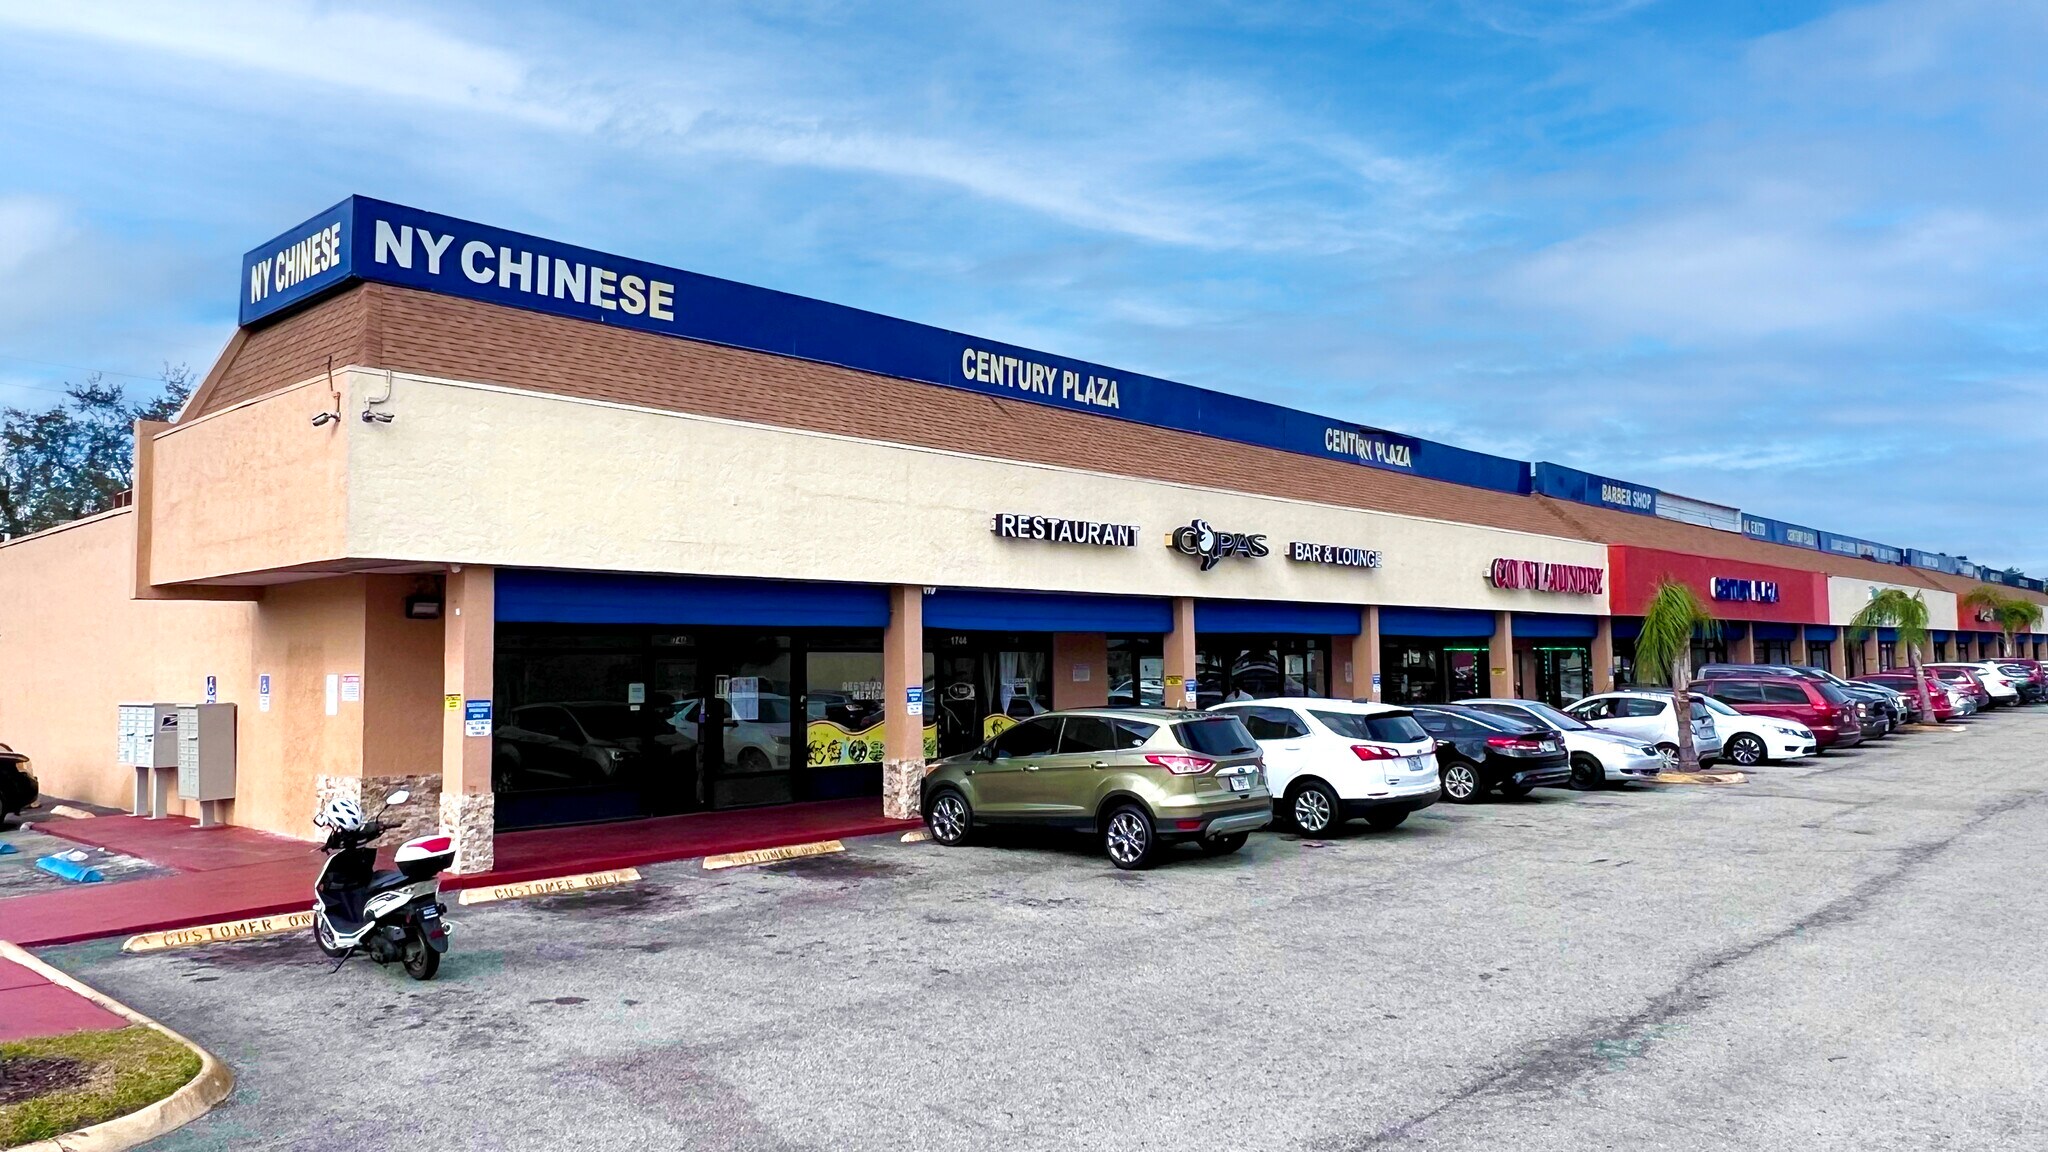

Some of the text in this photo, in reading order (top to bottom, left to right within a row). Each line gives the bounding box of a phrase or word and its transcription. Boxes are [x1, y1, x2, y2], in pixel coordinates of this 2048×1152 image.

[251, 222, 341, 304] NY CHINESE
[374, 219, 675, 321] NY CHINESE
[962, 348, 1120, 409] CENTURY PLAZA
[1375, 441, 1412, 467] PLAZA
[1602, 484, 1652, 509] BARBER SHOP
[999, 513, 1140, 547] RESTAURANT
[1295, 542, 1383, 568] BAR & LOUNGE
[1494, 558, 1603, 594] COIN LAUNDRY
[494, 873, 620, 899] CUSTOMER ONLY
[163, 914, 312, 947] CUSTOMER ON
